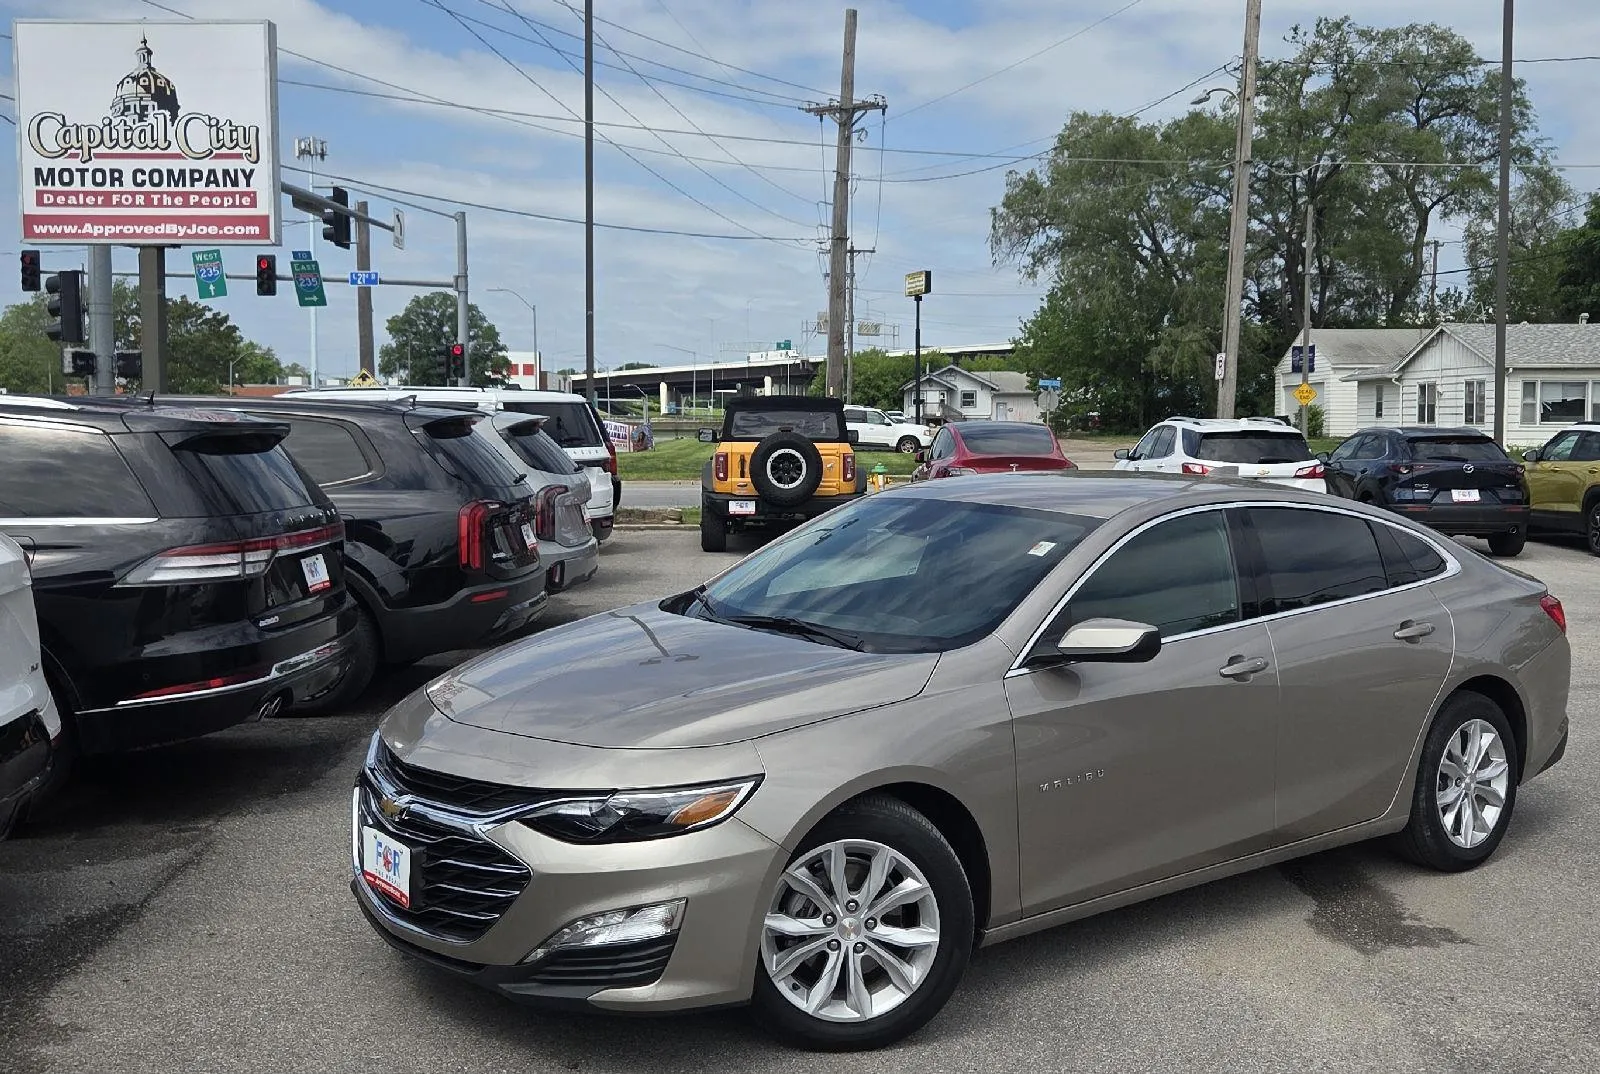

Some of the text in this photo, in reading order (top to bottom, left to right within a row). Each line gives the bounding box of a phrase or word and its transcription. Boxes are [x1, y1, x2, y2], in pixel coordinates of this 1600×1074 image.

[28, 111, 260, 164] Capital City
[34, 167, 256, 188] MOTOR COMPANY
[43, 193, 252, 208] Dealer FOR The People
[33, 223, 260, 237] www.ApprovedByJoe.com
[200, 267, 220, 278] 235
[300, 277, 318, 287] 235
[1040, 769, 1104, 792] MALIBU
